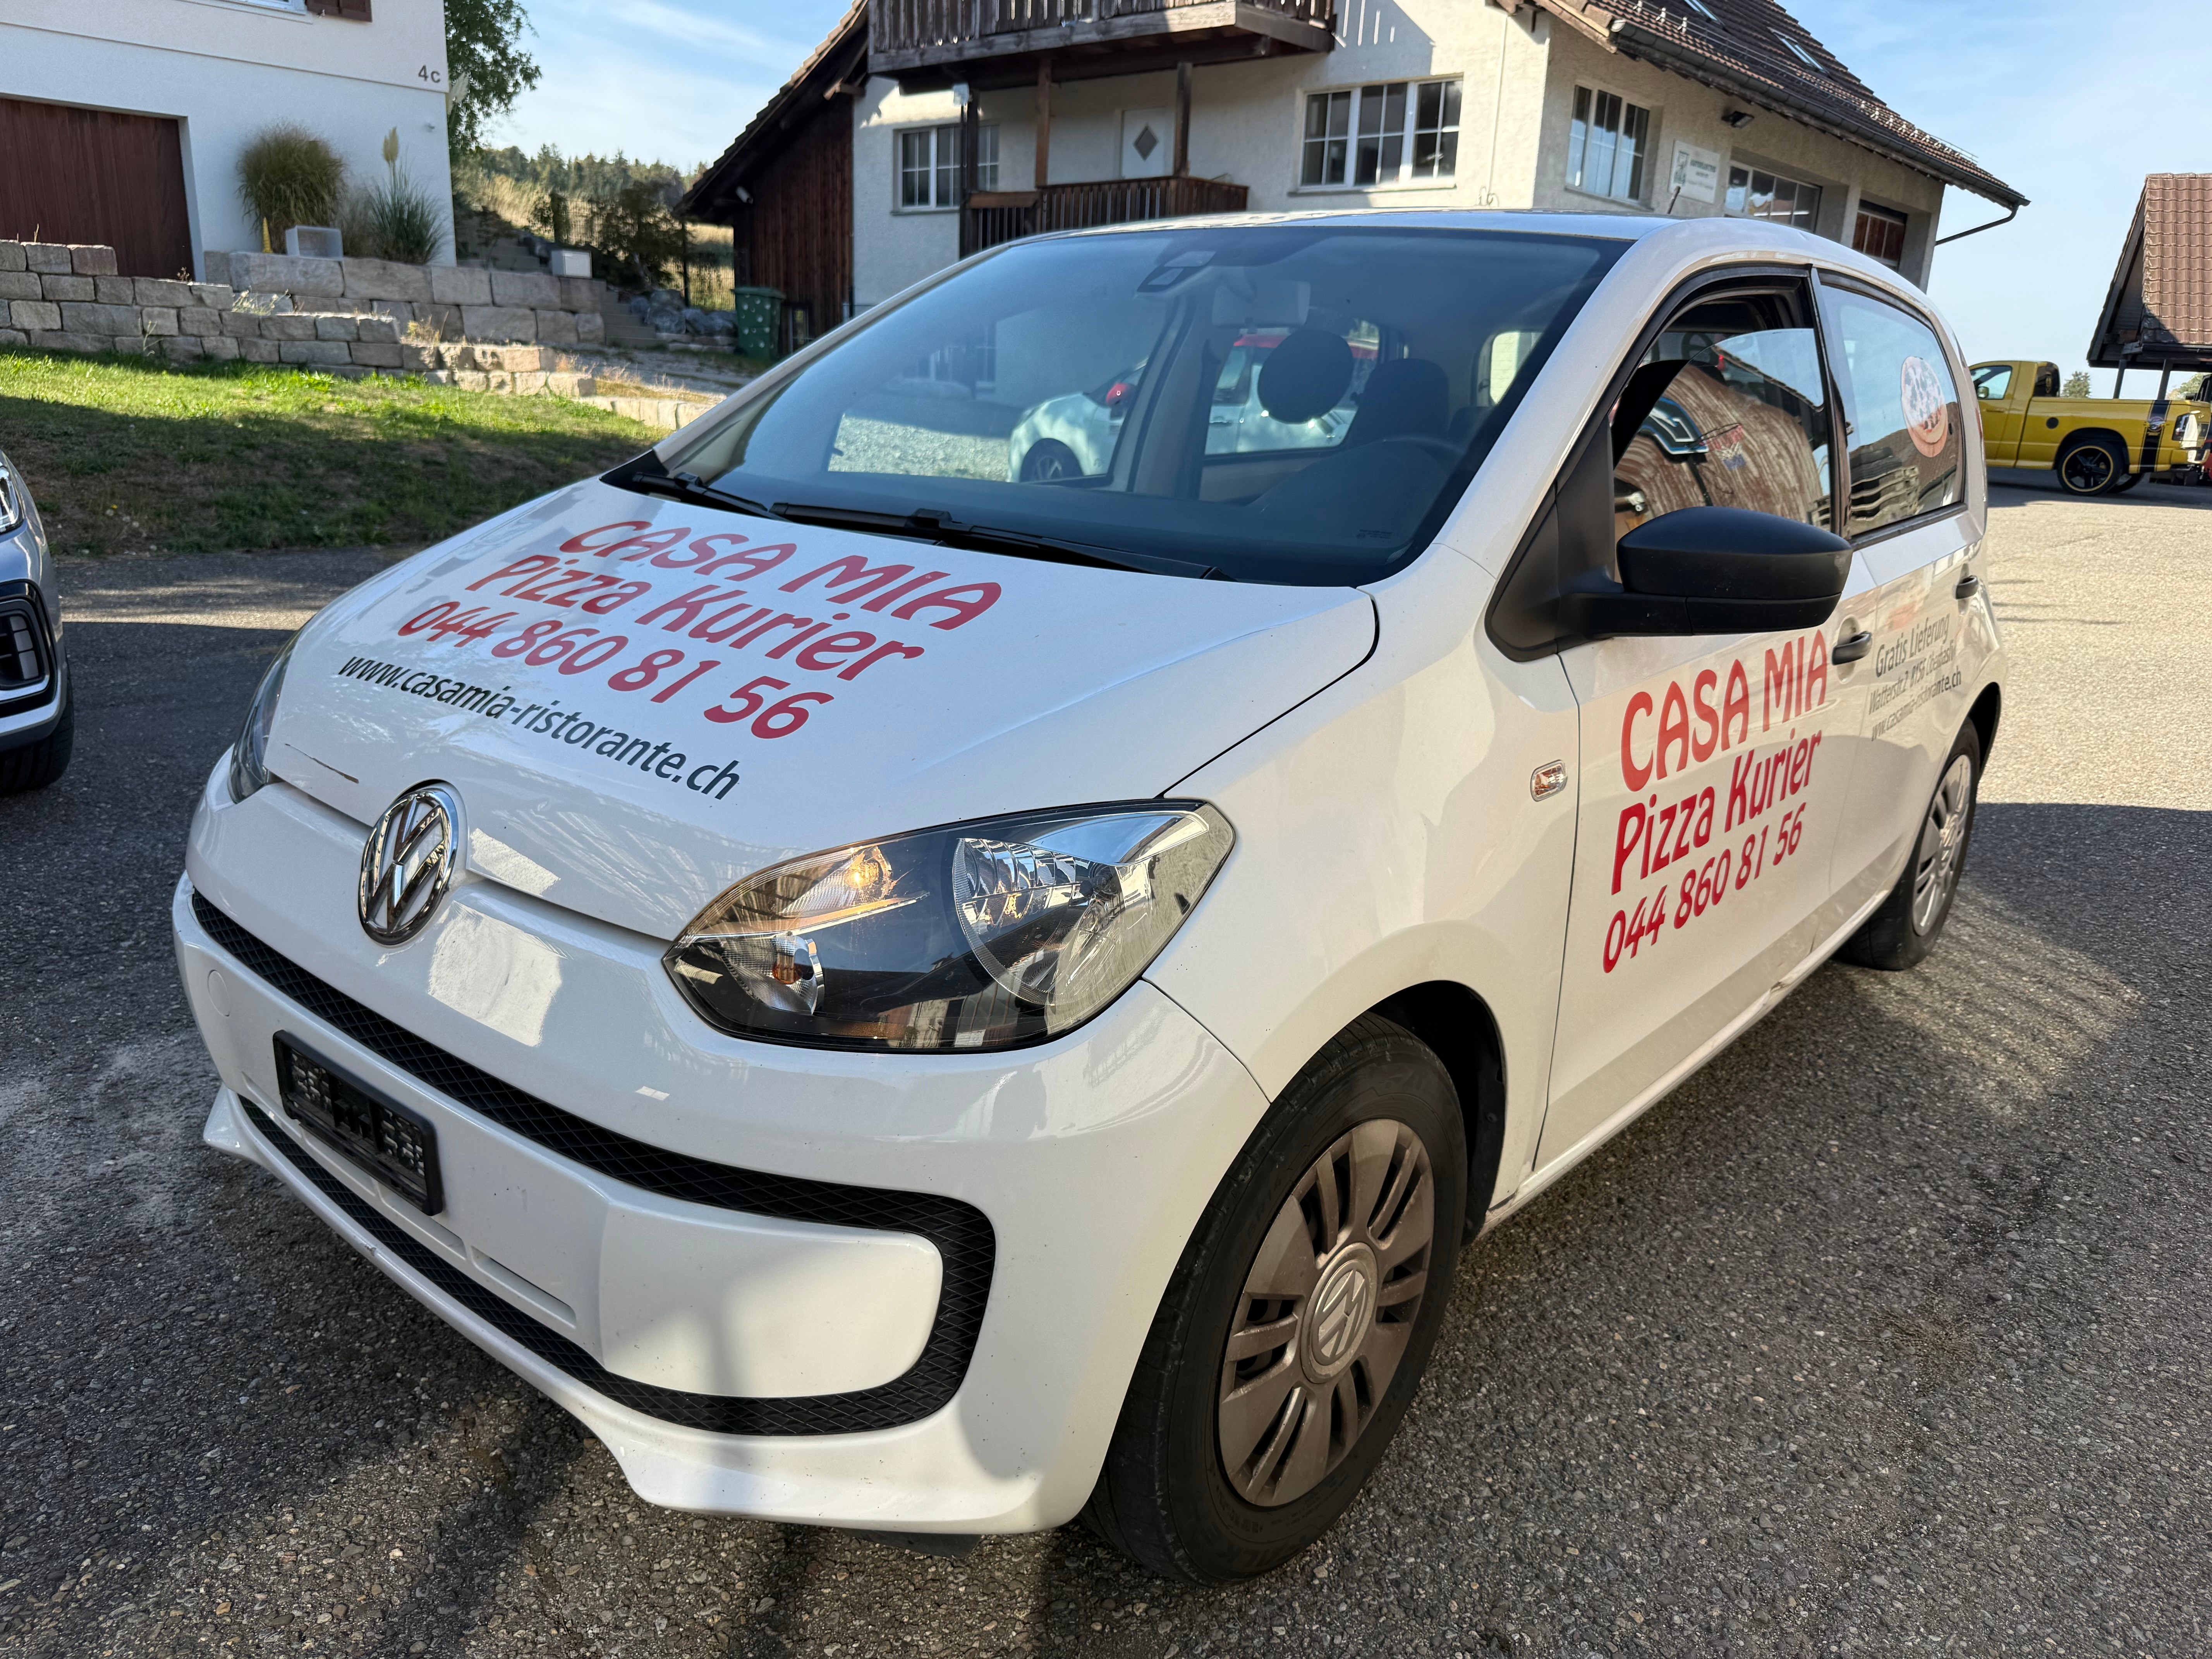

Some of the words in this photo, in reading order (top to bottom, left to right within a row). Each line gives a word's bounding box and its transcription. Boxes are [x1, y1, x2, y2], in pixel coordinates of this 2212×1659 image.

[418, 65, 441, 83] 4c
[466, 554, 651, 614] Pizza
[636, 584, 925, 681] Kurier
[560, 521, 796, 581] CASA
[779, 555, 1002, 630] MIA
[398, 601, 518, 647] 044
[491, 620, 628, 675] 860
[608, 649, 721, 703] 81
[704, 676, 834, 739] 56
[1621, 659, 1750, 792] CASA
[1763, 630, 1828, 732] MIA
[1876, 632, 1908, 678] Gratis
[1910, 613, 1950, 658] Lieferung
[338, 655, 740, 800] www.casamia-ristorante.ch
[1611, 786, 1716, 895] Pizza
[1724, 728, 1822, 833] Kurier
[1602, 885, 1668, 974] 044
[1673, 848, 1731, 930] 860
[1735, 825, 1769, 890] 81
[1772, 802, 1807, 866] 56
